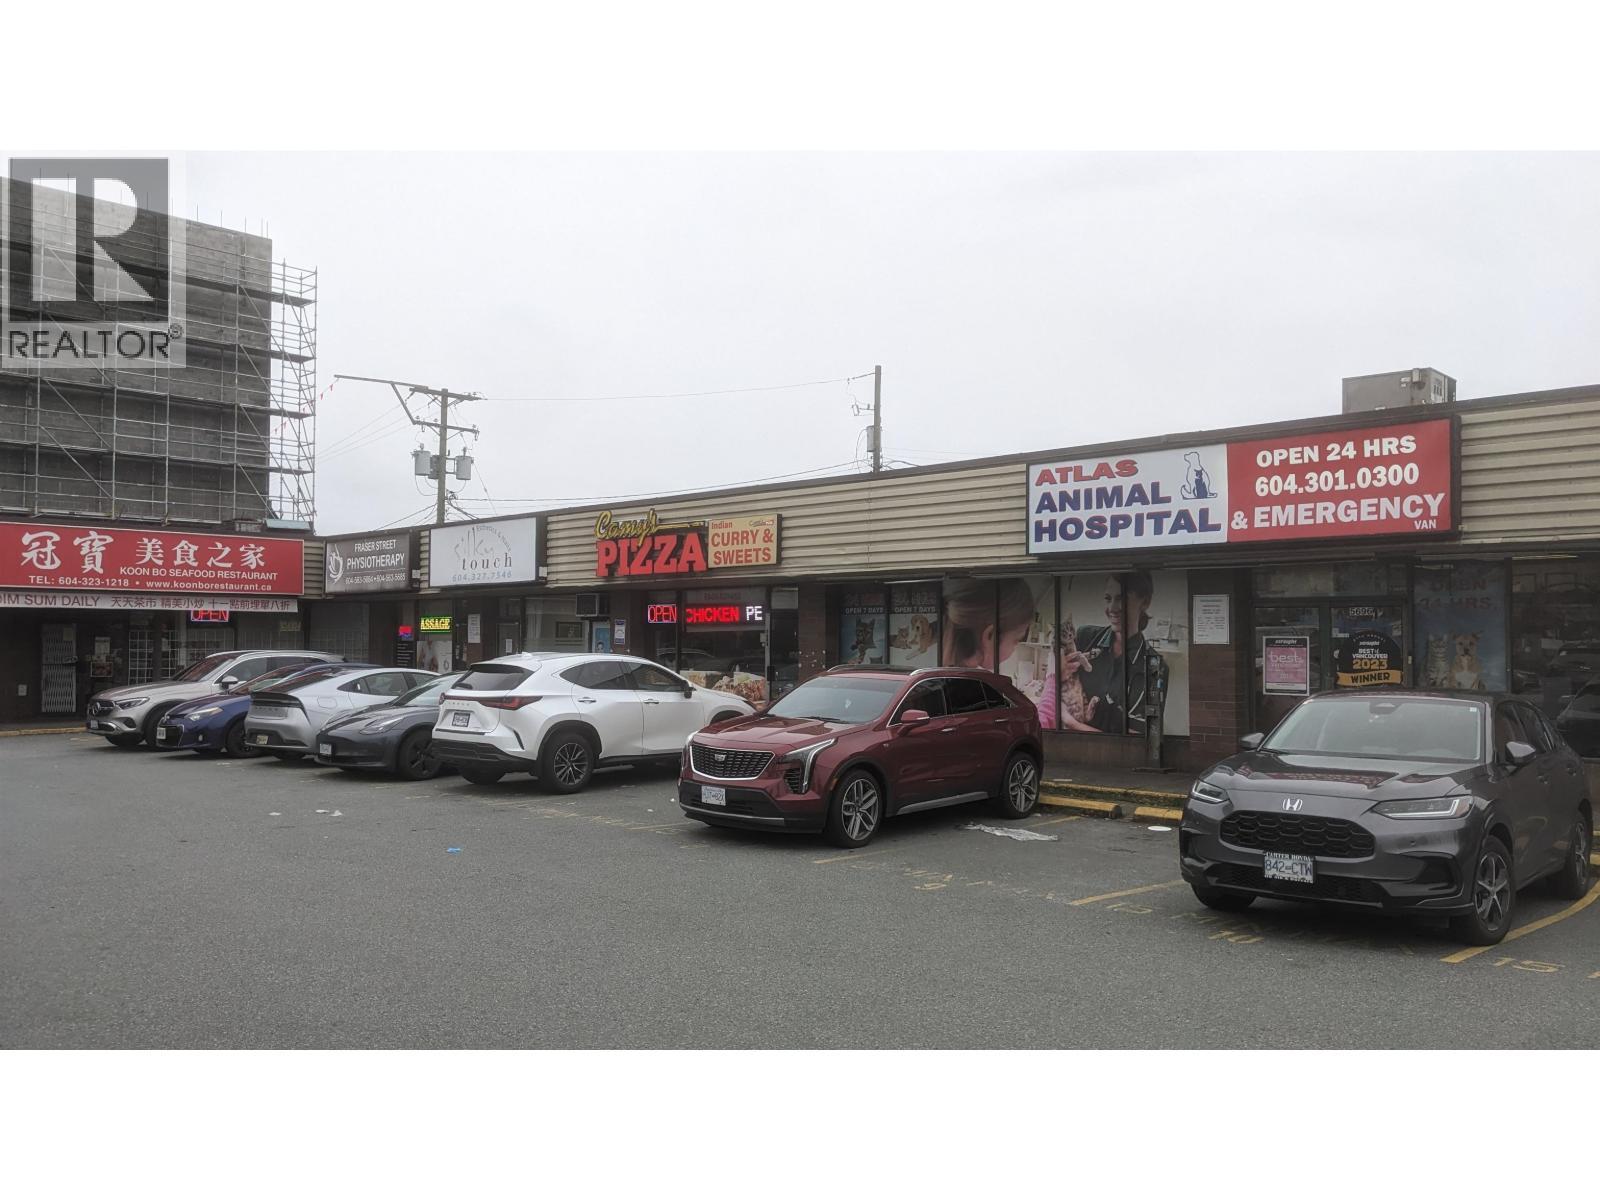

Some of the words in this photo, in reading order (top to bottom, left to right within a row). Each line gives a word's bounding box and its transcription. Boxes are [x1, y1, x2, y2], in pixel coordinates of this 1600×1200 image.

[1256, 446, 1319, 468] OPEN
[1326, 441, 1357, 462] 24
[1364, 435, 1417, 458] HRS
[1034, 458, 1139, 487] ATLAS
[1255, 462, 1419, 497] 604.301.0300
[1035, 481, 1172, 514] ANIMAL
[1230, 512, 1248, 531] &
[1254, 493, 1445, 529] EMERGENCY
[711, 521, 733, 530] Indian
[1034, 508, 1221, 543] HOSPITAL
[1414, 519, 1437, 531] VAN
[354, 541, 376, 553] FRASER
[375, 539, 397, 551] STREET
[711, 529, 760, 547] CURRY
[762, 528, 774, 543] &
[20, 531, 114, 574] 冠寶
[135, 537, 266, 569] 美食之家
[462, 552, 512, 570] touch
[596, 532, 707, 577] PIZZA
[713, 547, 772, 565] SWEETS
[346, 553, 405, 570] PHYSIOTHERAPY
[119, 567, 150, 577] KOON
[152, 568, 167, 577] BO
[169, 568, 216, 579] SEAFOOD
[217, 571, 279, 581] RESTAURANT
[28, 575, 55, 585] TEL:
[58, 576, 129, 587] 604-323-1218
[146, 581, 272, 591] www.koonborestaurant.ca
[24, 594, 57, 606] SUM
[61, 595, 101, 607] DAILY
[192, 610, 228, 621] OPEN
[649, 605, 676, 622] OPEN
[686, 606, 739, 623] CHICKEN
[745, 606, 762, 621] PE
[1352, 659, 1388, 670] 2023
[1351, 672, 1391, 684] WINNER
